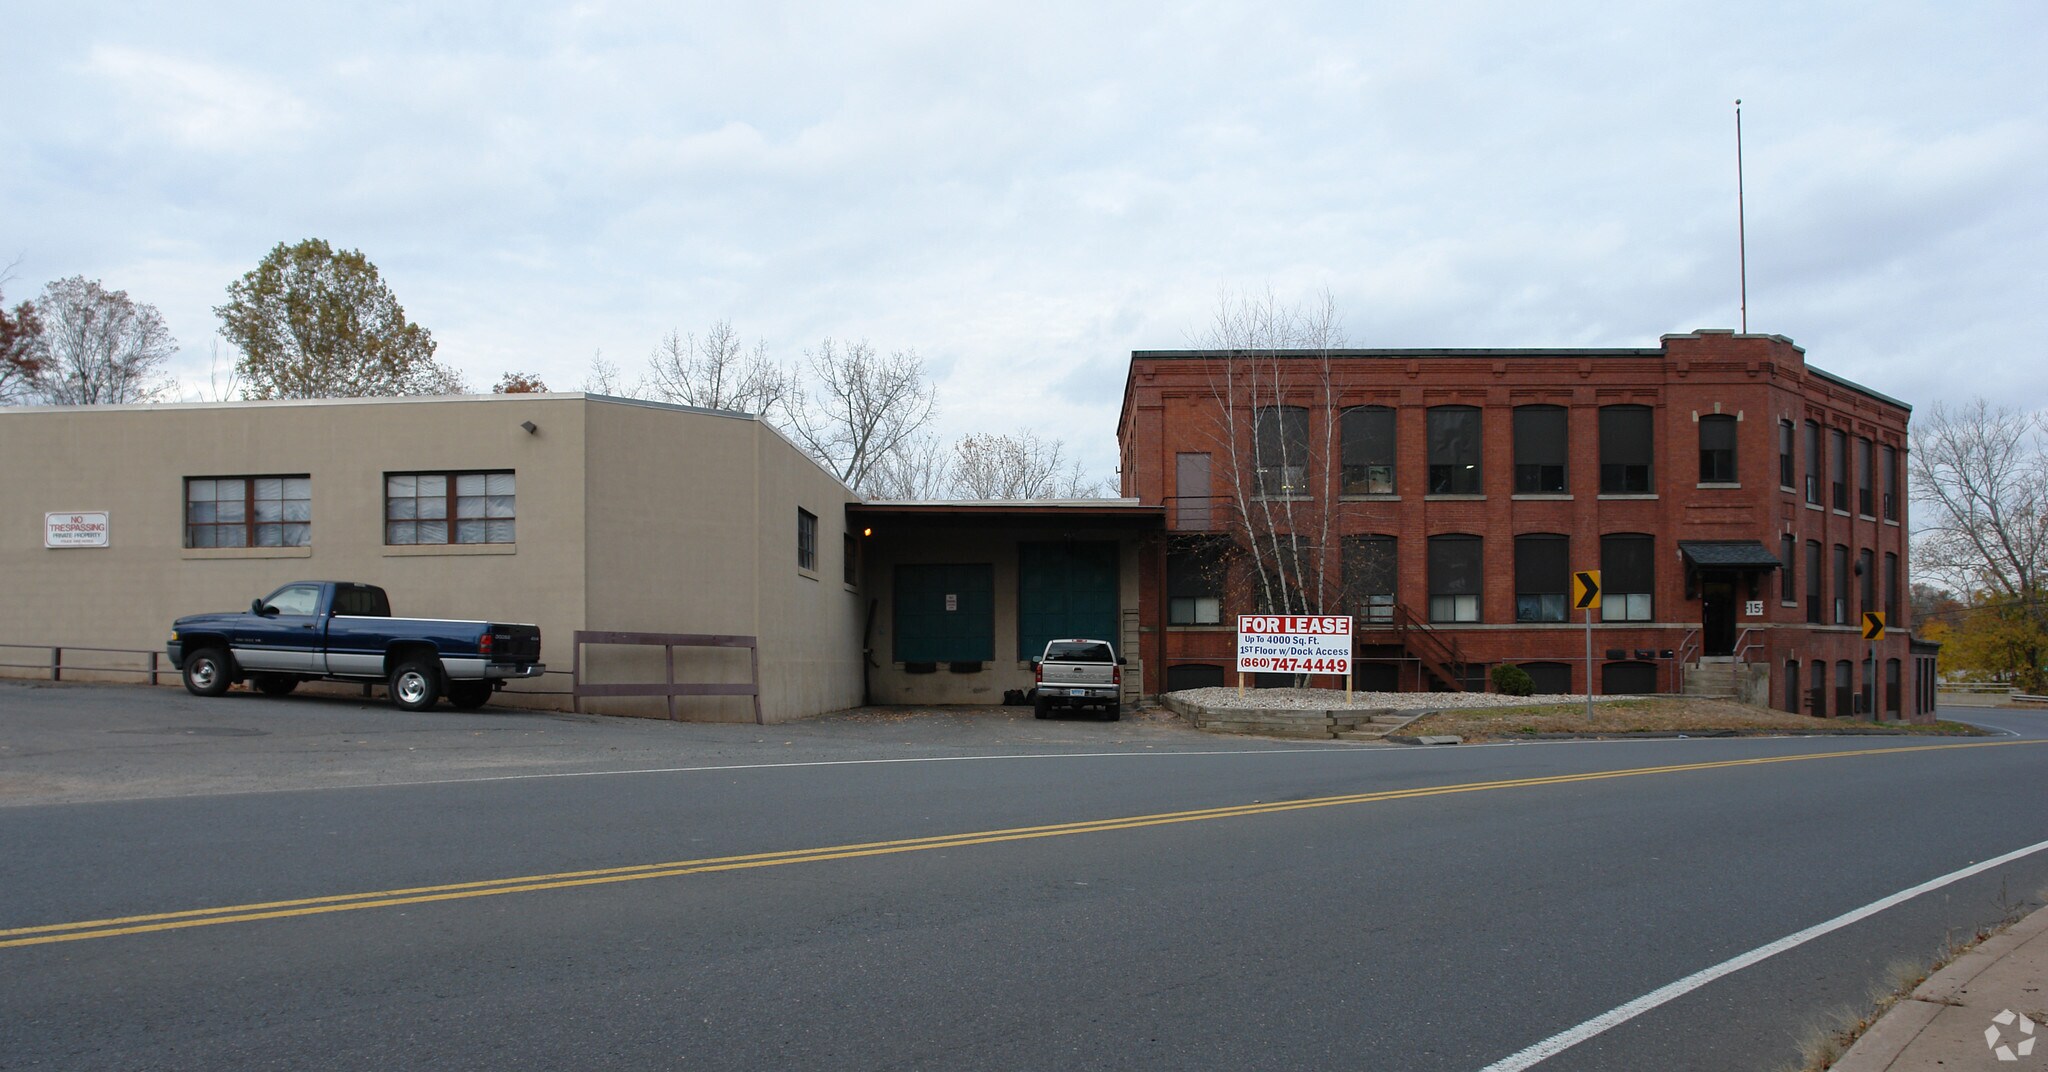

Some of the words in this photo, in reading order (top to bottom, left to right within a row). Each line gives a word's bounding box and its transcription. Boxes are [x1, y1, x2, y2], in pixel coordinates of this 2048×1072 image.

[49, 523, 105, 531] TRESPASSING
[1750, 603, 1761, 613] 15
[1241, 617, 1280, 633] FOR
[1285, 618, 1348, 634] LEASE
[1267, 636, 1290, 644] 4000
[1292, 636, 1306, 646] Sq.
[1308, 636, 1319, 644] Ft.
[1240, 646, 1253, 654] 1ST
[1255, 646, 1277, 655] Floor
[1315, 647, 1349, 655] Access
[1271, 658, 1347, 672] 747-4449
